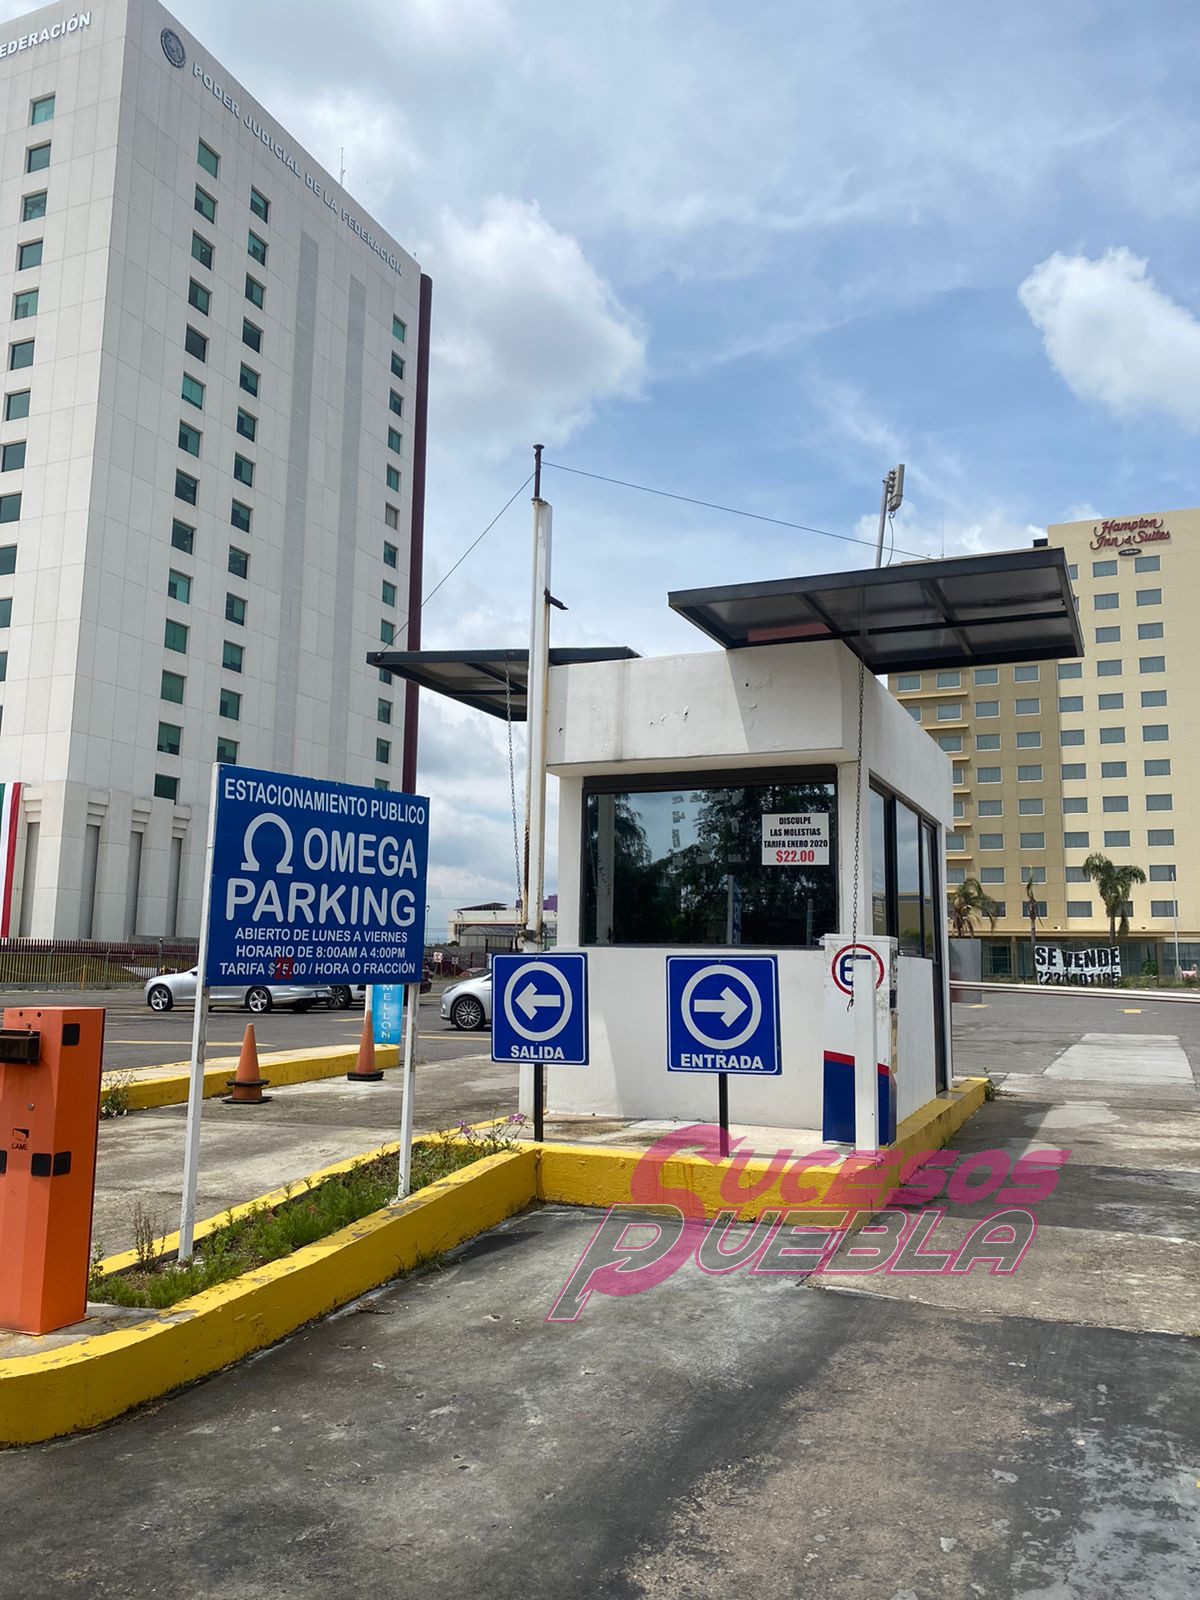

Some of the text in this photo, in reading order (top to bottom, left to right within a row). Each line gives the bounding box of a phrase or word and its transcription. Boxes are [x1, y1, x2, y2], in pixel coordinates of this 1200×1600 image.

[192, 62, 402, 277] PODER JUDICIAL DE LA FEDERACIÓN
[1094, 518, 1164, 537] Hampton
[1090, 536, 1124, 550] Inn
[1133, 531, 1170, 543] Suites
[224, 778, 425, 825] ESTACIONAMIENTO PUBLICO
[779, 816, 811, 825] DISCULPE
[770, 828, 821, 837] LAS MOLESTIAS
[764, 839, 828, 848] TARIFA ENERO 2020
[303, 827, 418, 879] OMEGA
[776, 849, 815, 863] $22.00
[225, 877, 416, 927] PARKING
[234, 927, 408, 943] ABIERTO DE LUNES A VIERNES
[236, 945, 406, 959] HORARIO DE 8:00AM A 4:00PM
[1035, 947, 1120, 968] SE VENDE
[220, 962, 265, 975] TARIFA
[314, 962, 350, 975] HORA
[352, 962, 361, 975] O
[363, 960, 415, 974] FRACCIÓN
[510, 1045, 565, 1060] SALIDA
[680, 1053, 765, 1070] ENTRADA
